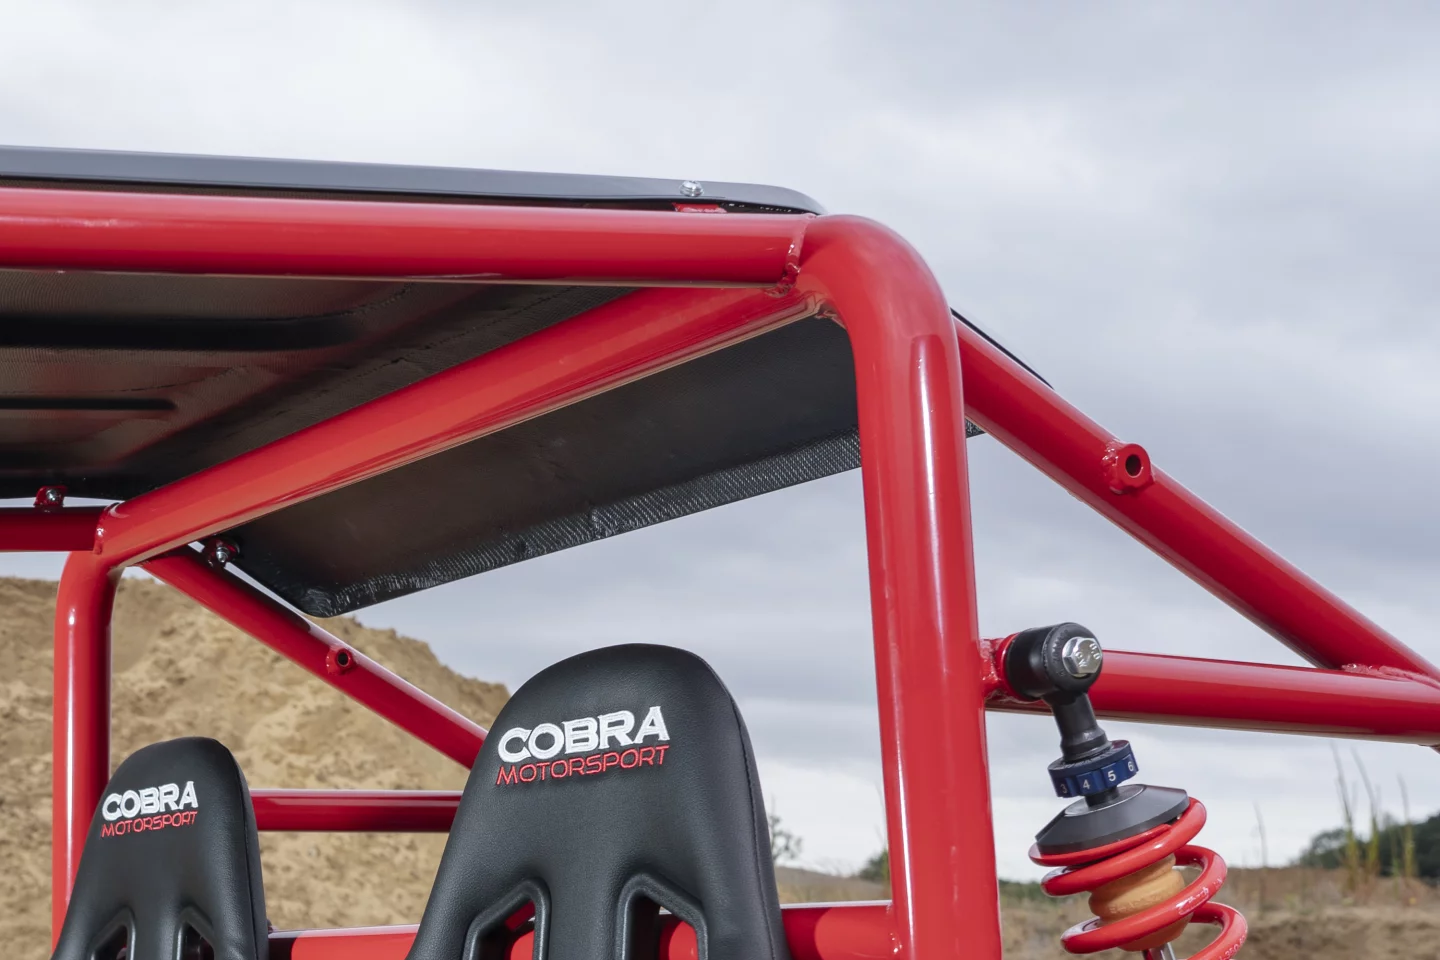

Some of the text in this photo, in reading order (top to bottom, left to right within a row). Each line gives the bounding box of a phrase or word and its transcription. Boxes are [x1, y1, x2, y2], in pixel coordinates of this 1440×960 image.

[496, 706, 671, 763] COBRA
[496, 745, 670, 785] MOTORSPORT
[1060, 761, 1135, 794] 3 4 5 6
[101, 781, 199, 821] COBRA
[101, 811, 198, 838] MOTORSPORT
